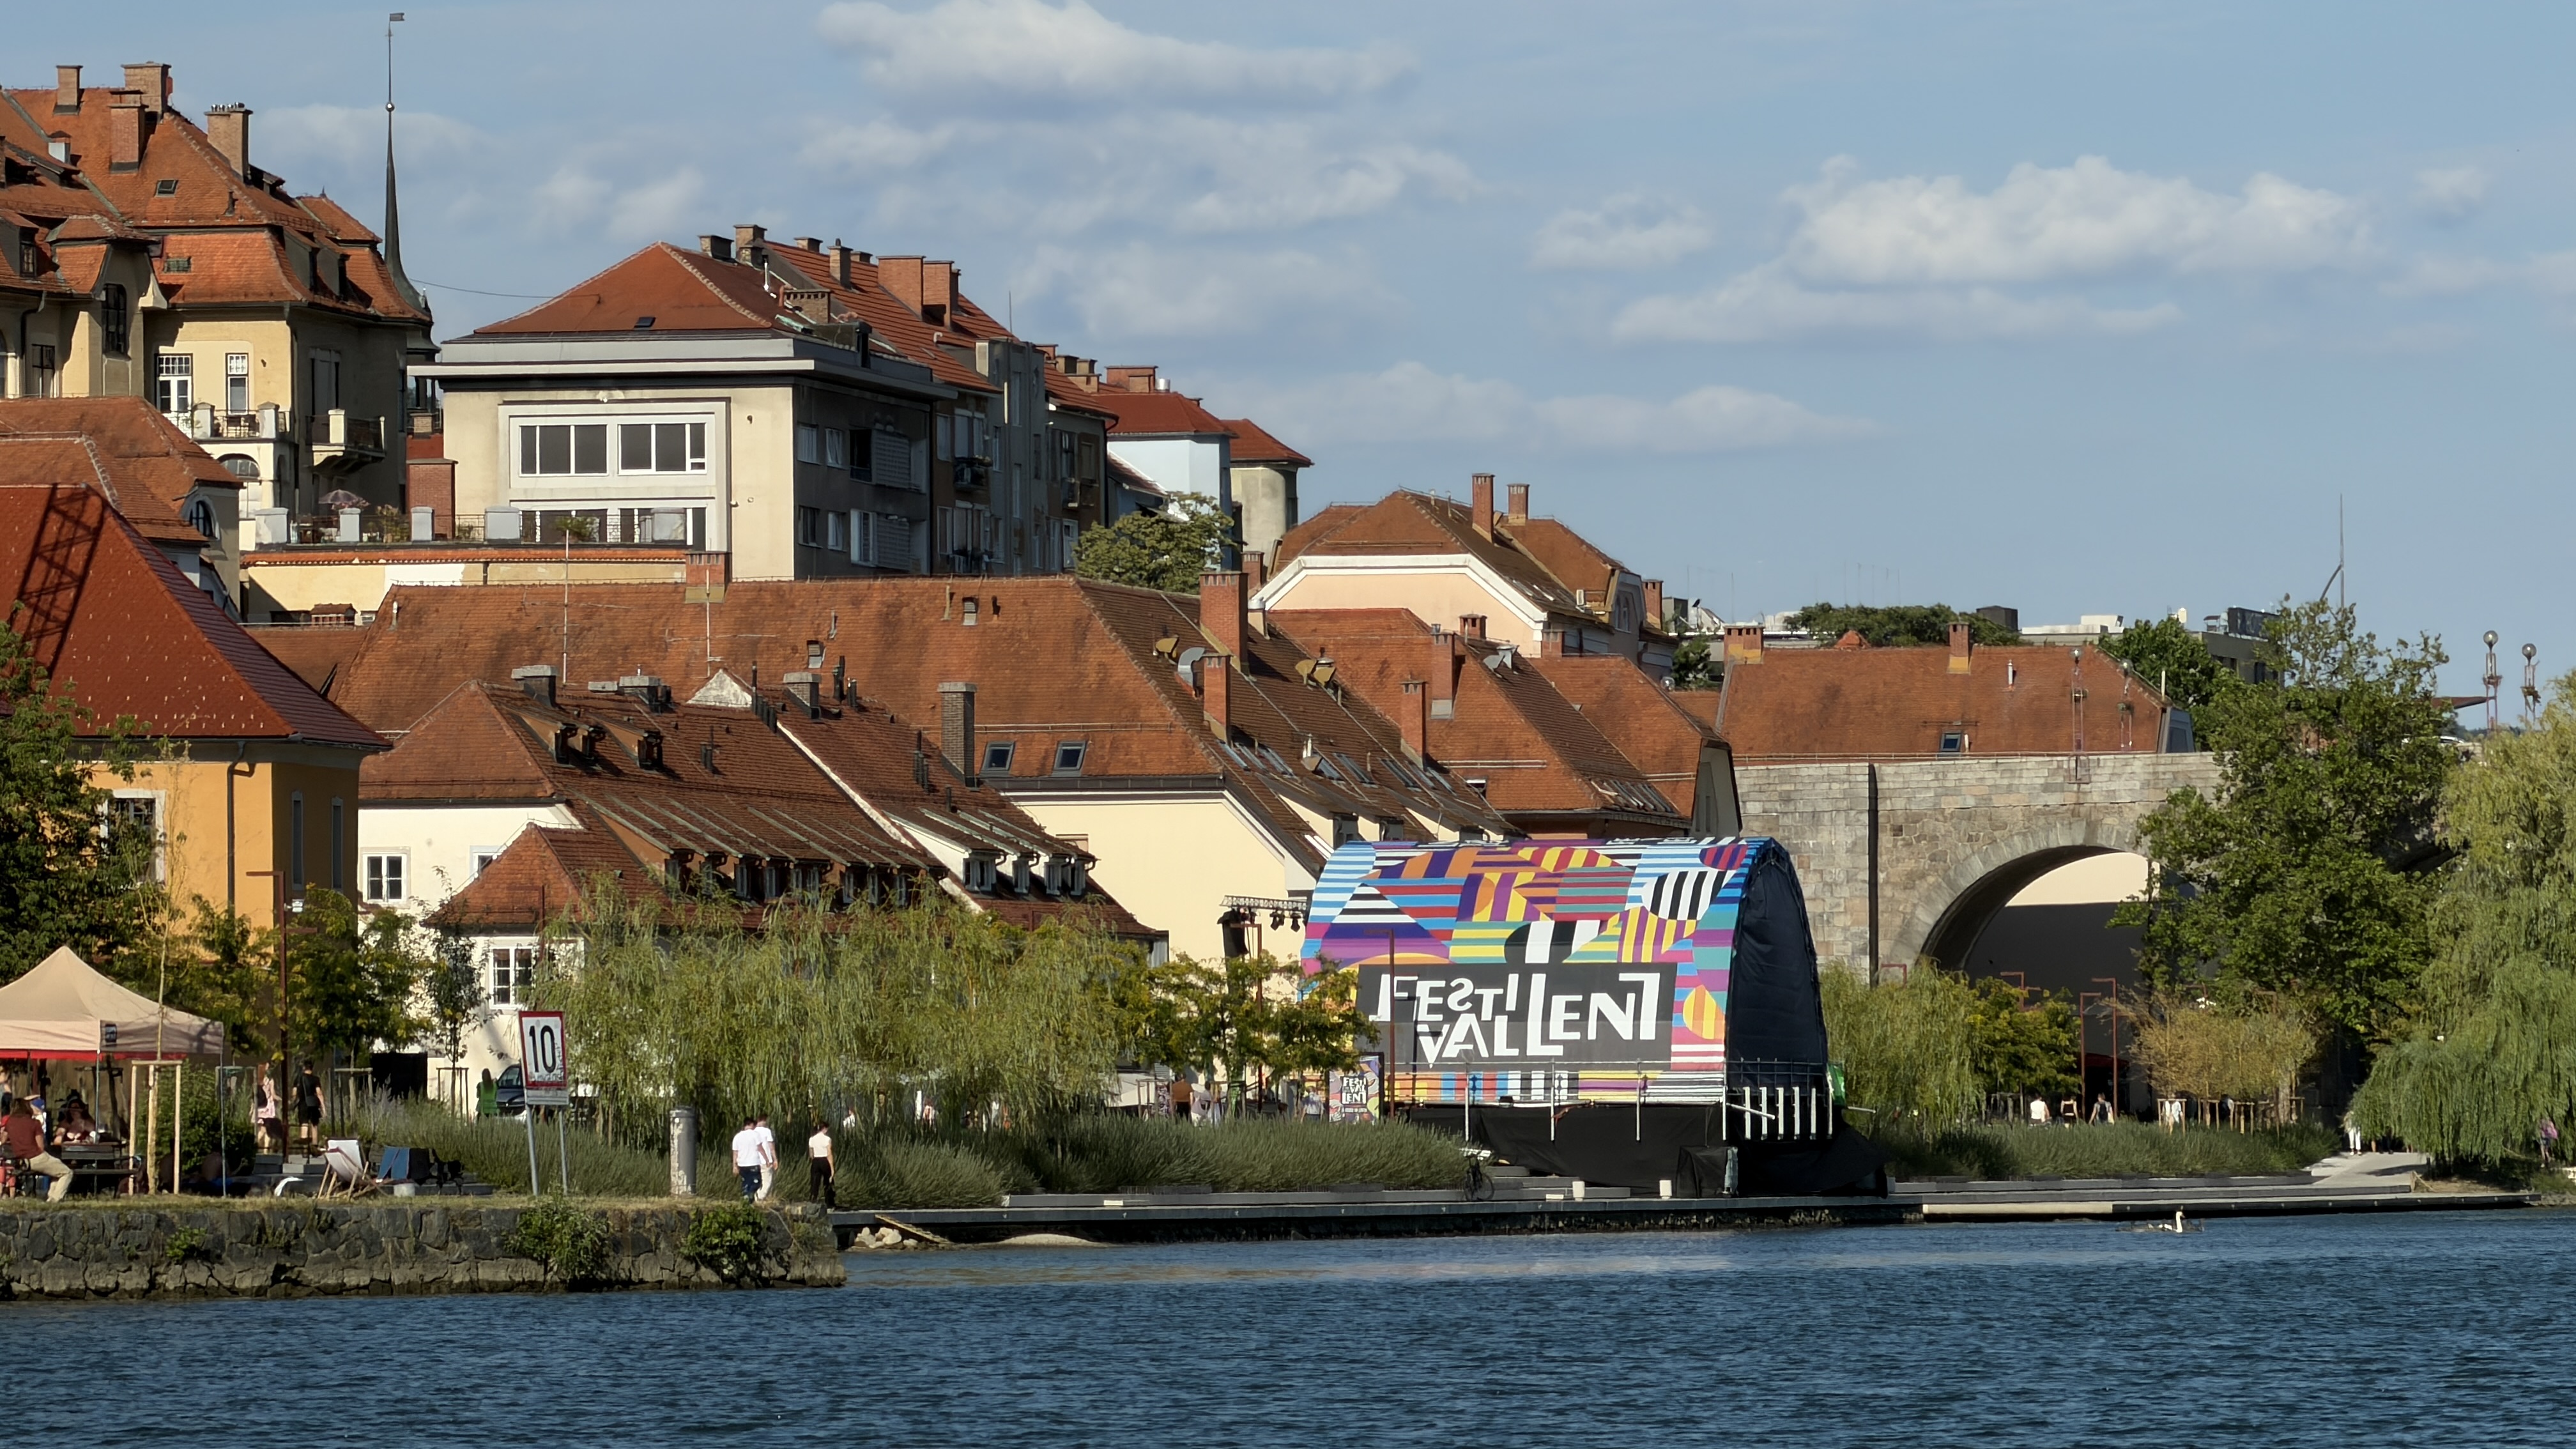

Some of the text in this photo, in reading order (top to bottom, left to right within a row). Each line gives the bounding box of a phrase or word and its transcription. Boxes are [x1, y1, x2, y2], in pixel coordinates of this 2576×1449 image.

[1368, 973, 1519, 1022] FESTI
[1526, 972, 1660, 1056] LENT
[529, 1025, 556, 1073] 10
[1416, 1013, 1519, 1068] VAL
